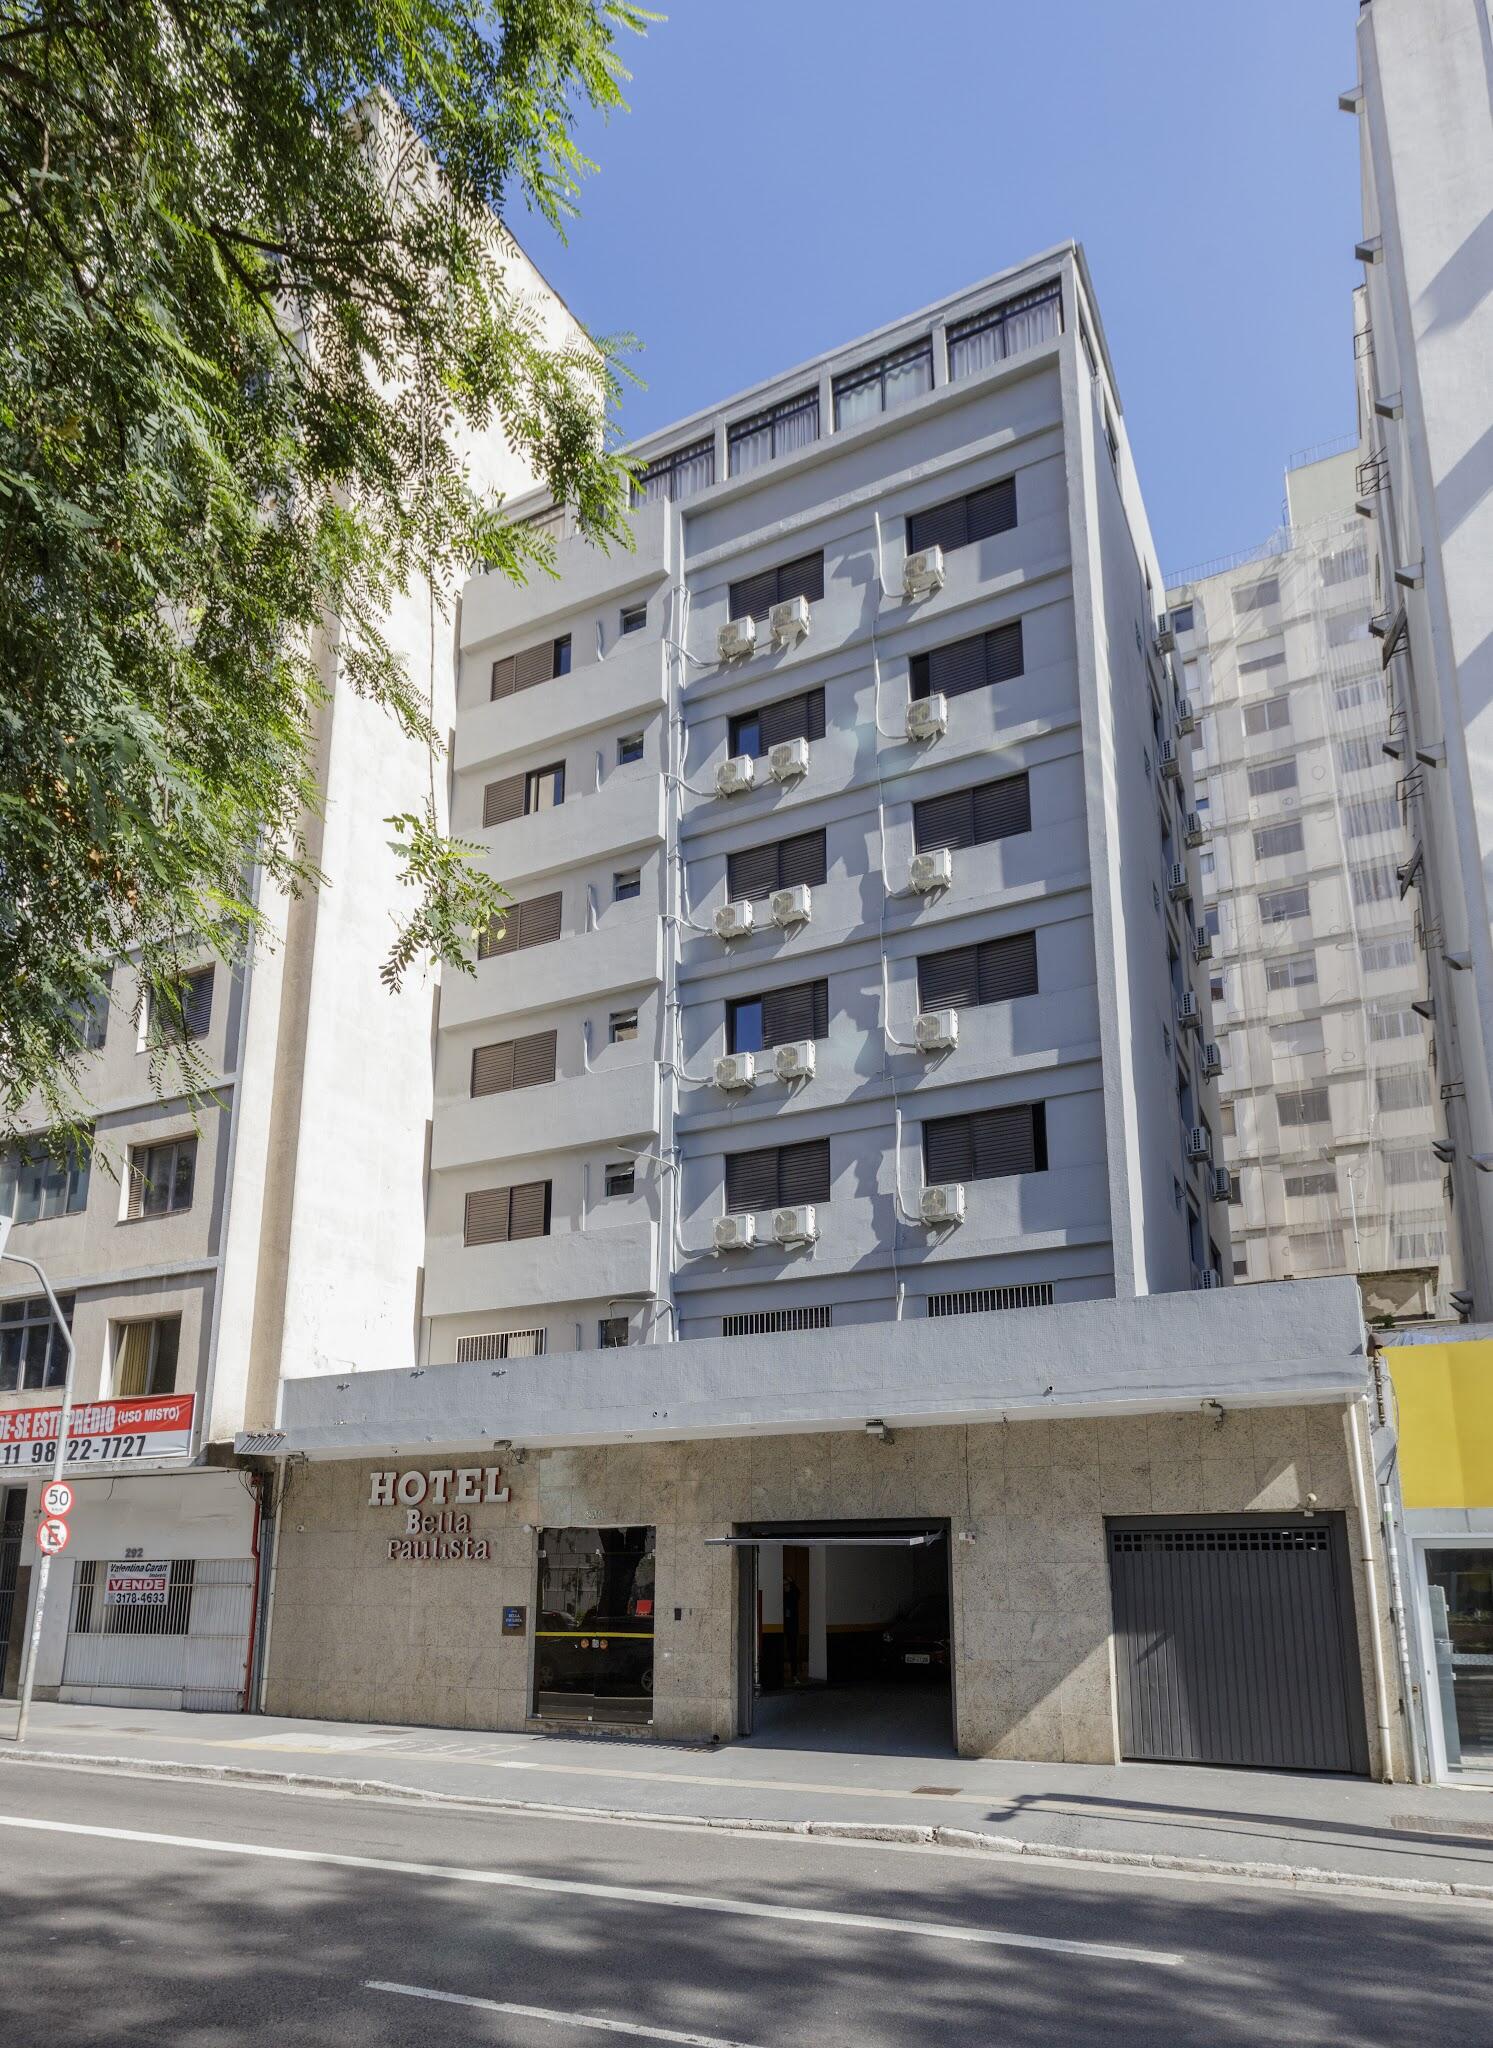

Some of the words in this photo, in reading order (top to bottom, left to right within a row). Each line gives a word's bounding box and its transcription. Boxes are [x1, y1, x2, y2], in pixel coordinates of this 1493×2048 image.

[117, 1410, 142, 1426] (USO
[144, 1406, 180, 1422] MISTO)
[4, 1444, 21, 1464] 11
[31, 1435, 146, 1463] 9822-7727
[368, 1467, 511, 1506] HOTEL
[48, 1489, 69, 1505] 50
[405, 1509, 471, 1535] Bella
[125, 1548, 144, 1558] 292
[110, 1563, 144, 1573] Valentina
[145, 1563, 168, 1572] Caran
[110, 1580, 164, 1590] VENDE
